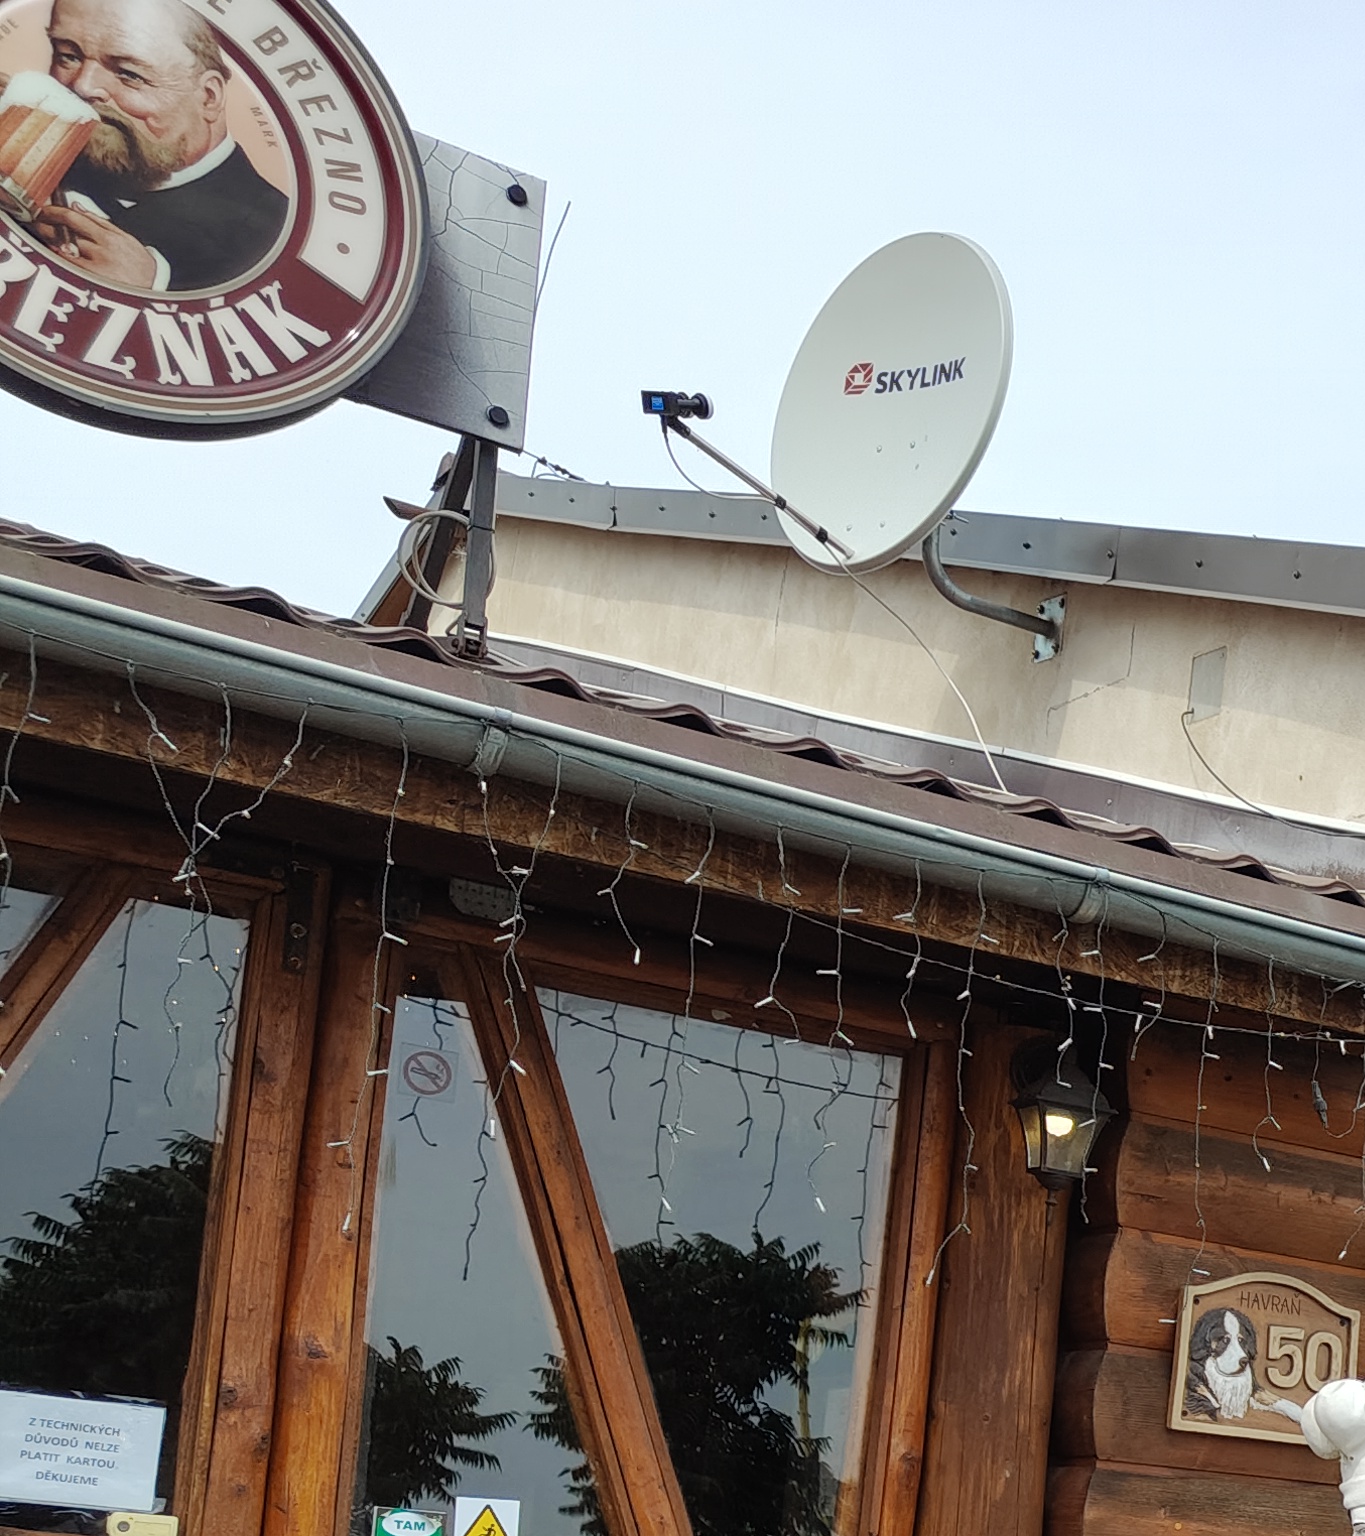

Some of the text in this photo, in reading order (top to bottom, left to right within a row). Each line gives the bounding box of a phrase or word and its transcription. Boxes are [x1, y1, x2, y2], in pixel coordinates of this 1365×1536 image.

[250, 105, 279, 149] MARK
[252, 25, 367, 218] BŘEZNO
[875, 357, 966, 394] SKYLINK
[1240, 1290, 1301, 1316] HAVRAŇ
[1266, 1324, 1343, 1392] 50
[29, 1417, 121, 1437] Z TECHNICKÝCH
[24, 1432, 120, 1453] DŮVODŮ NELZE
[20, 1449, 61, 1463] PLATIT
[35, 1470, 99, 1486] DĚKUJEME
[394, 1519, 426, 1532] TAM
